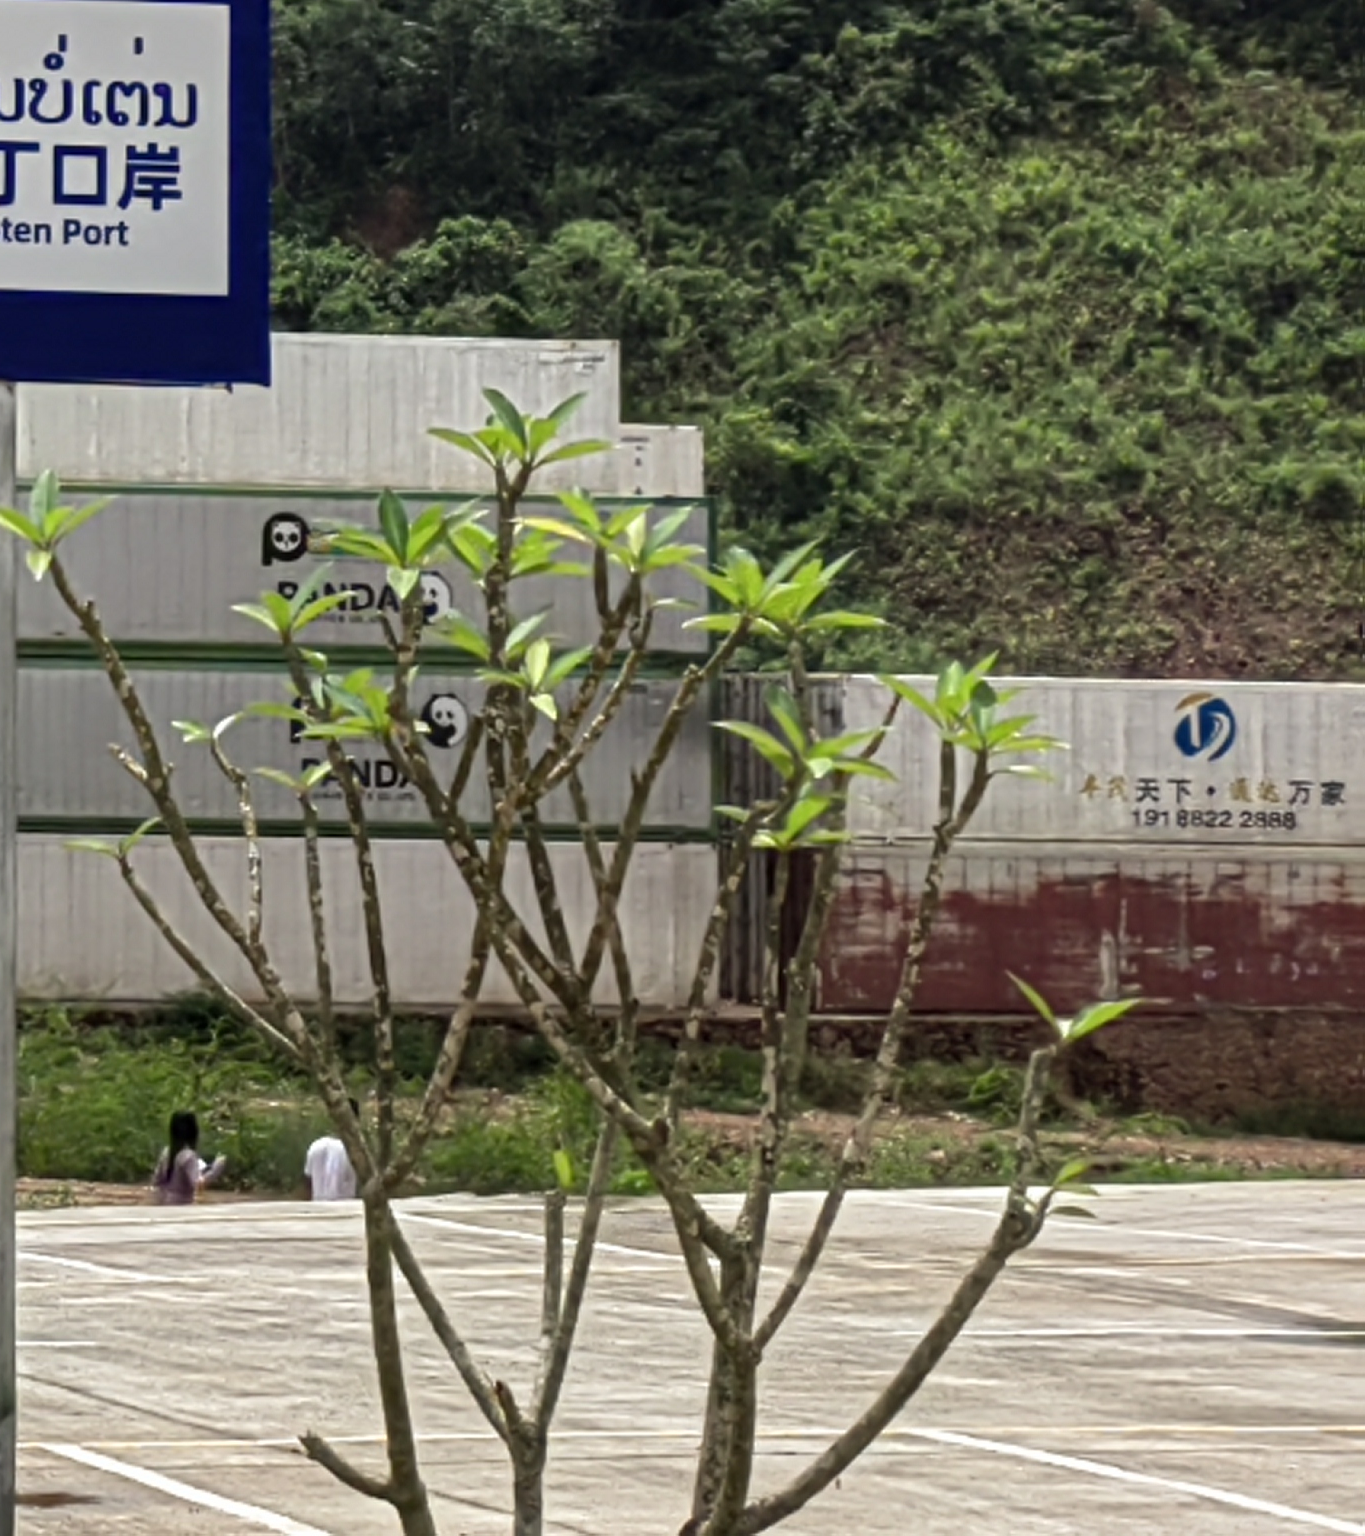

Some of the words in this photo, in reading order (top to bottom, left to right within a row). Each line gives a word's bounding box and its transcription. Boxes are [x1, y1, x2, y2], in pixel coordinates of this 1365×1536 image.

[61, 217, 130, 248] Port
[277, 580, 400, 614] PNDA
[302, 758, 416, 789] PND
